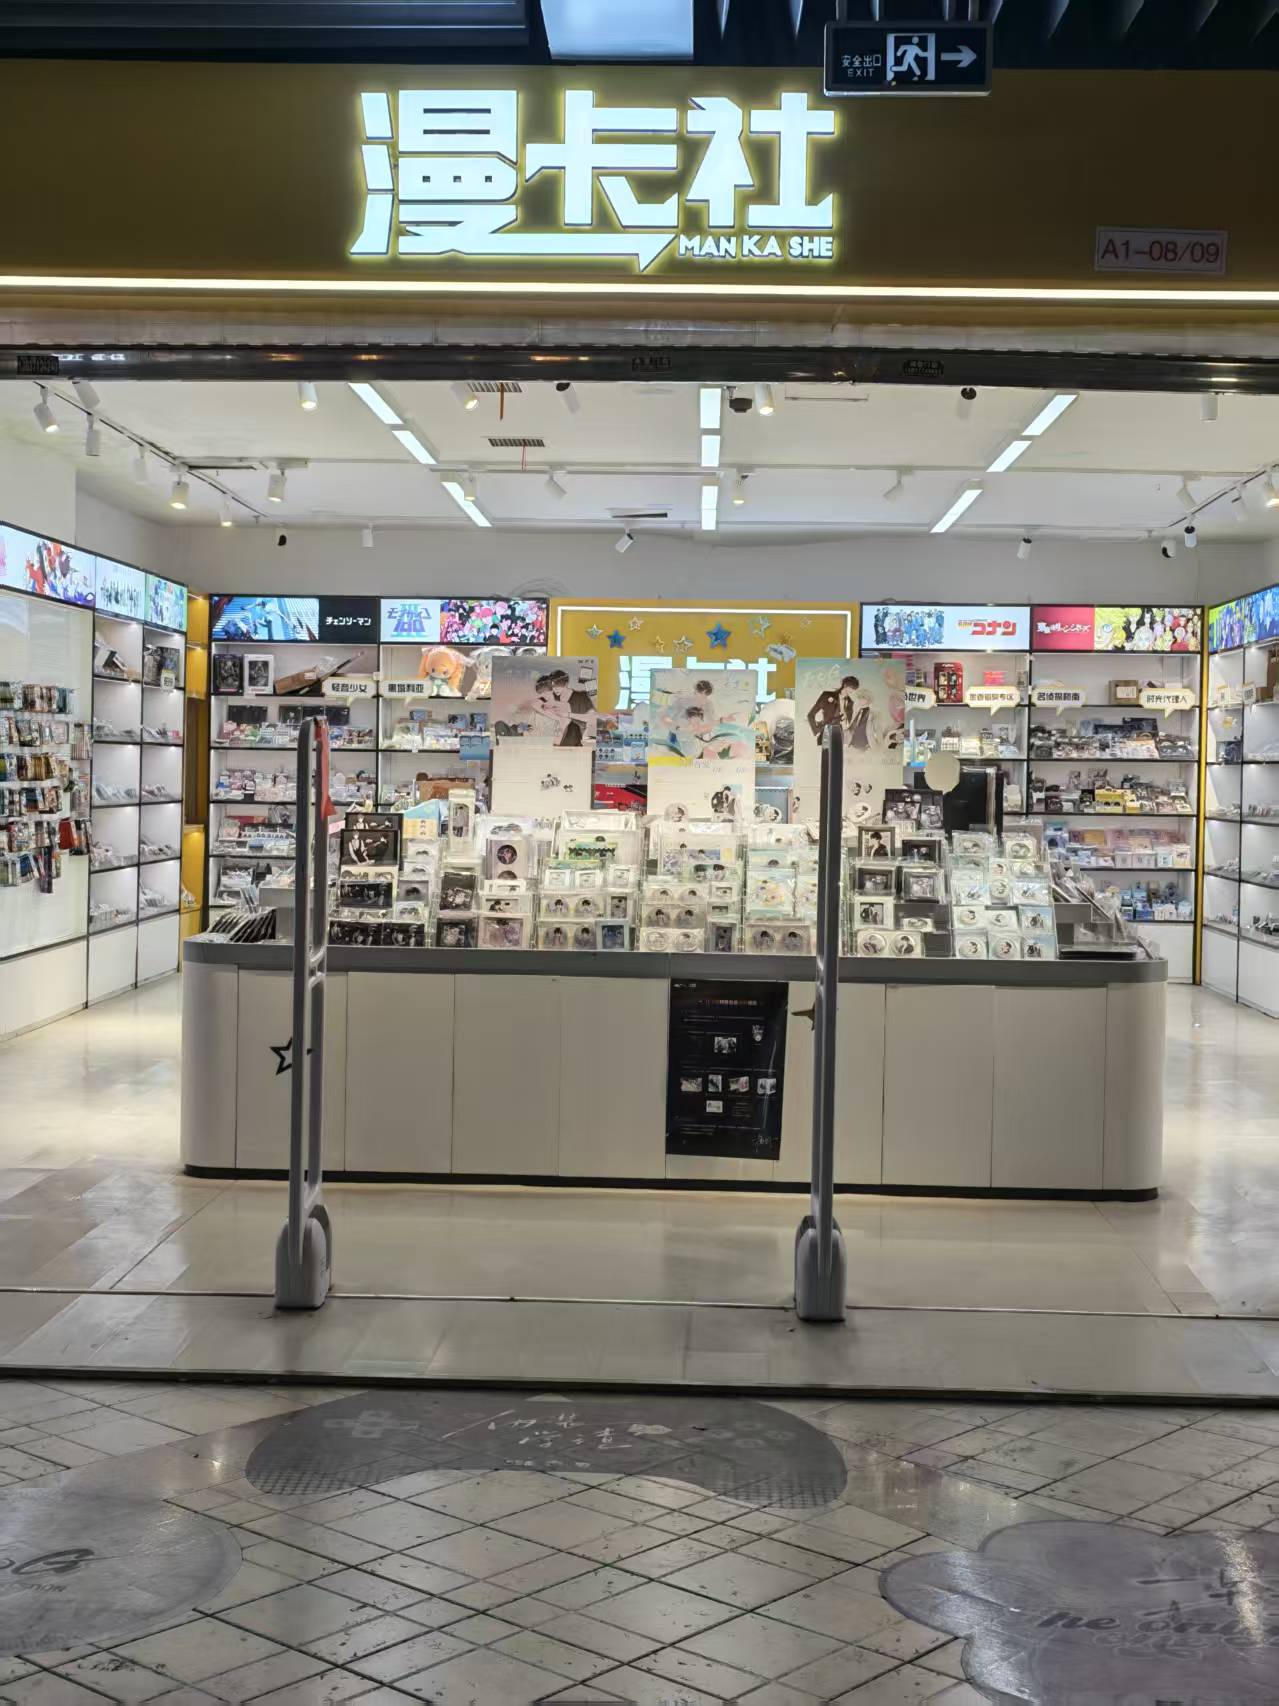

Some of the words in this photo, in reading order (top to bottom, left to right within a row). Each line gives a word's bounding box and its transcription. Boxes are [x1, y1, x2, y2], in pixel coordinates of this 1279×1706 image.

[841, 54, 882, 68] 安全出口
[847, 68, 875, 77] EXIT
[350, 89, 835, 273] 漫卡社
[678, 235, 736, 259] MAN
[741, 235, 783, 258] KA
[788, 235, 834, 258] SHE
[1101, 239, 1220, 265] A1-08/09
[325, 616, 372, 626] チェンソーマン
[331, 683, 368, 693] 轻音少女
[1146, 694, 1188, 704] 时光代理人
